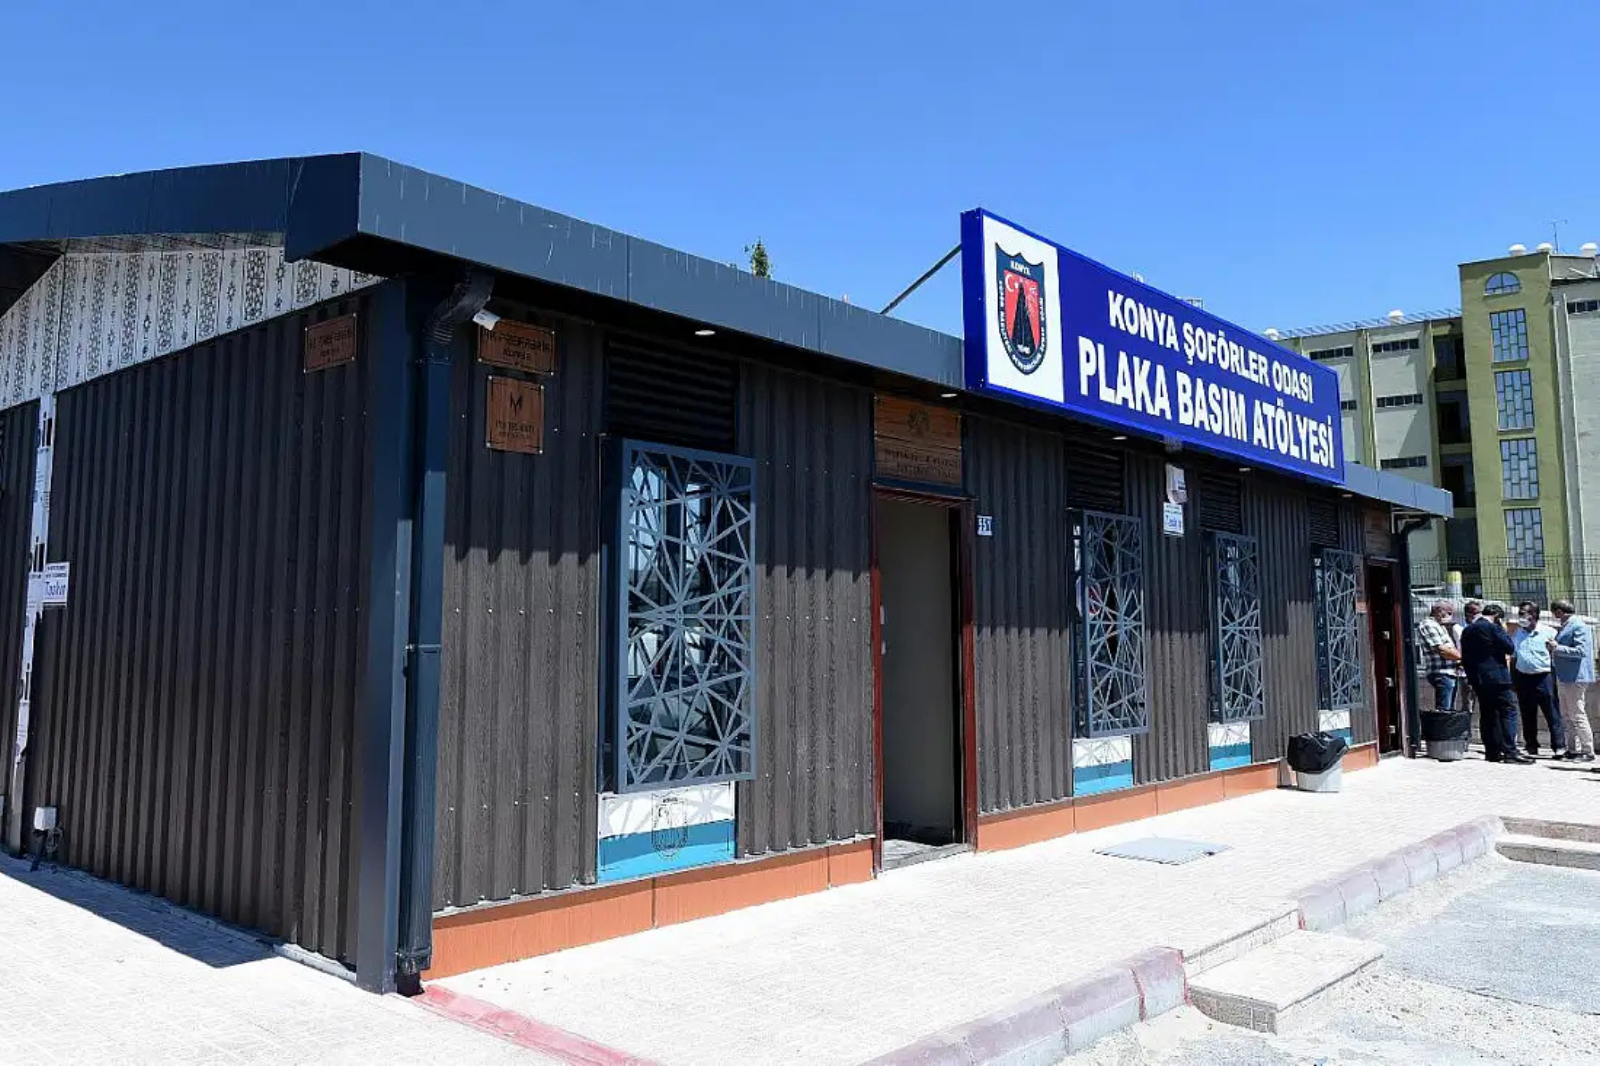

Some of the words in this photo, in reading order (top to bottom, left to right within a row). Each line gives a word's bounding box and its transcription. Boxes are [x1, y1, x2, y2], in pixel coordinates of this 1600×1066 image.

[1078, 335, 1173, 420] PLAKA
[1176, 369, 1248, 442] BASIM
[1253, 397, 1335, 469] ATÖLYESİ
[1107, 289, 1180, 352] KONYA
[1182, 322, 1271, 387] ŞOFÖRLER
[1272, 360, 1314, 404] ODASI
